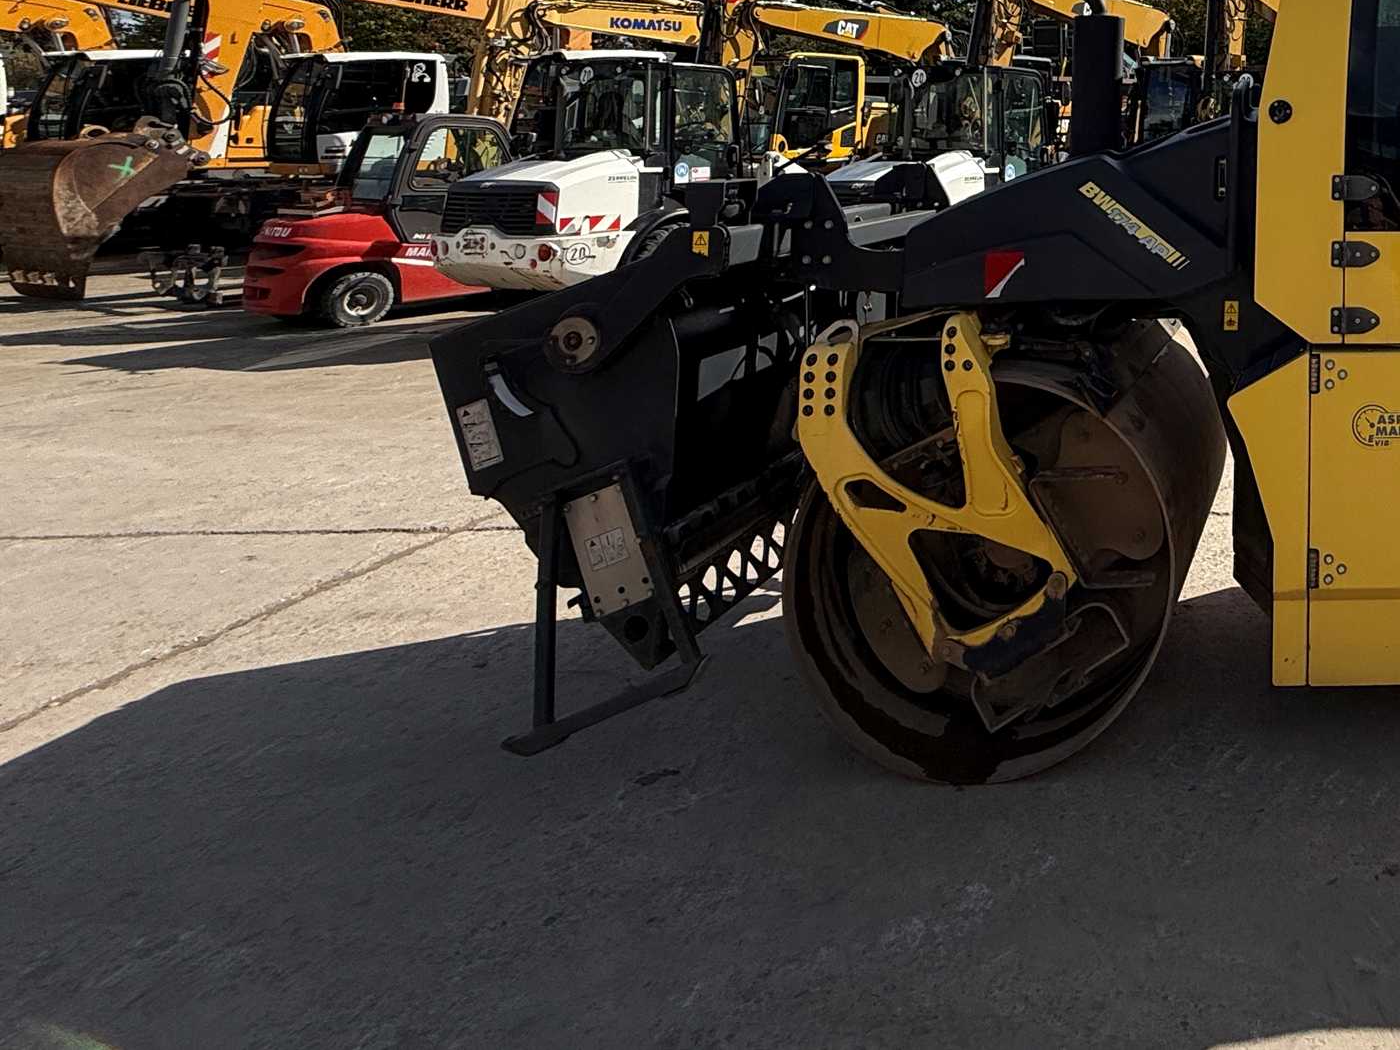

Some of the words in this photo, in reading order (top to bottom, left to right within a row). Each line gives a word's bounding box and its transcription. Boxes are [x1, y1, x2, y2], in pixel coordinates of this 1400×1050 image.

[609, 17, 682, 32] KOMATSU
[837, 20, 859, 39] CAT
[569, 246, 586, 261] 20
